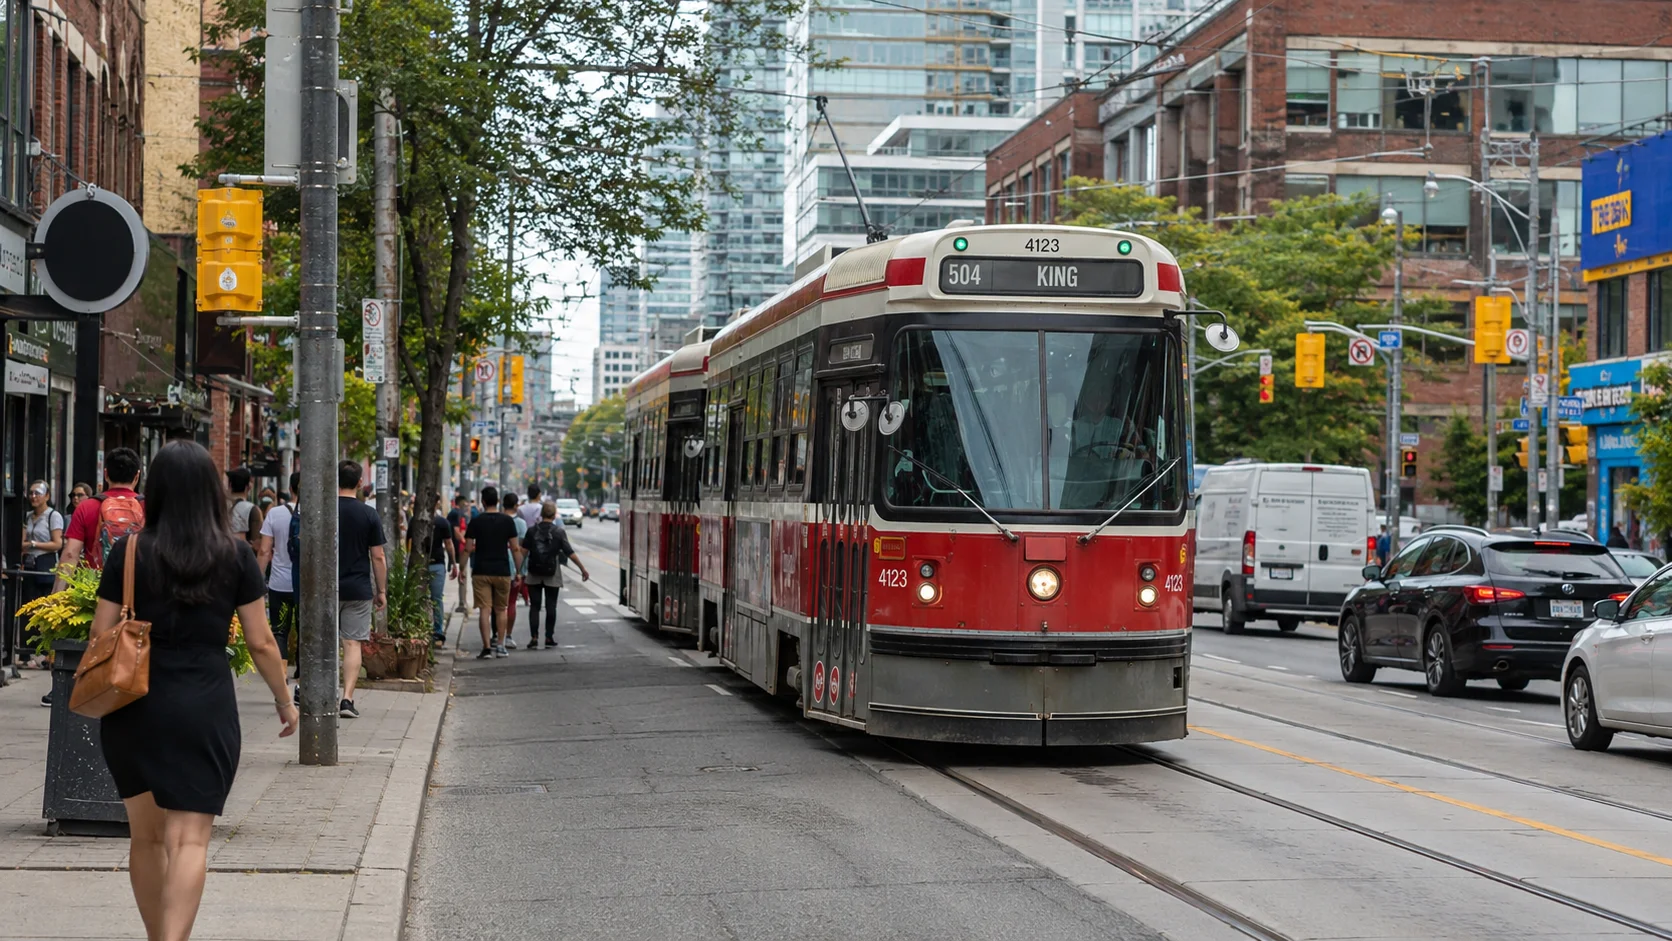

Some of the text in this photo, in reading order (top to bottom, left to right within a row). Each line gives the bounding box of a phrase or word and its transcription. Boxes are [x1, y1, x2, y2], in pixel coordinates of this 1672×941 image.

[1024, 237, 1060, 253] 4123
[948, 263, 1078, 288] 504 KING
[878, 568, 908, 588] 4123
[1164, 574, 1183, 592] 4123
